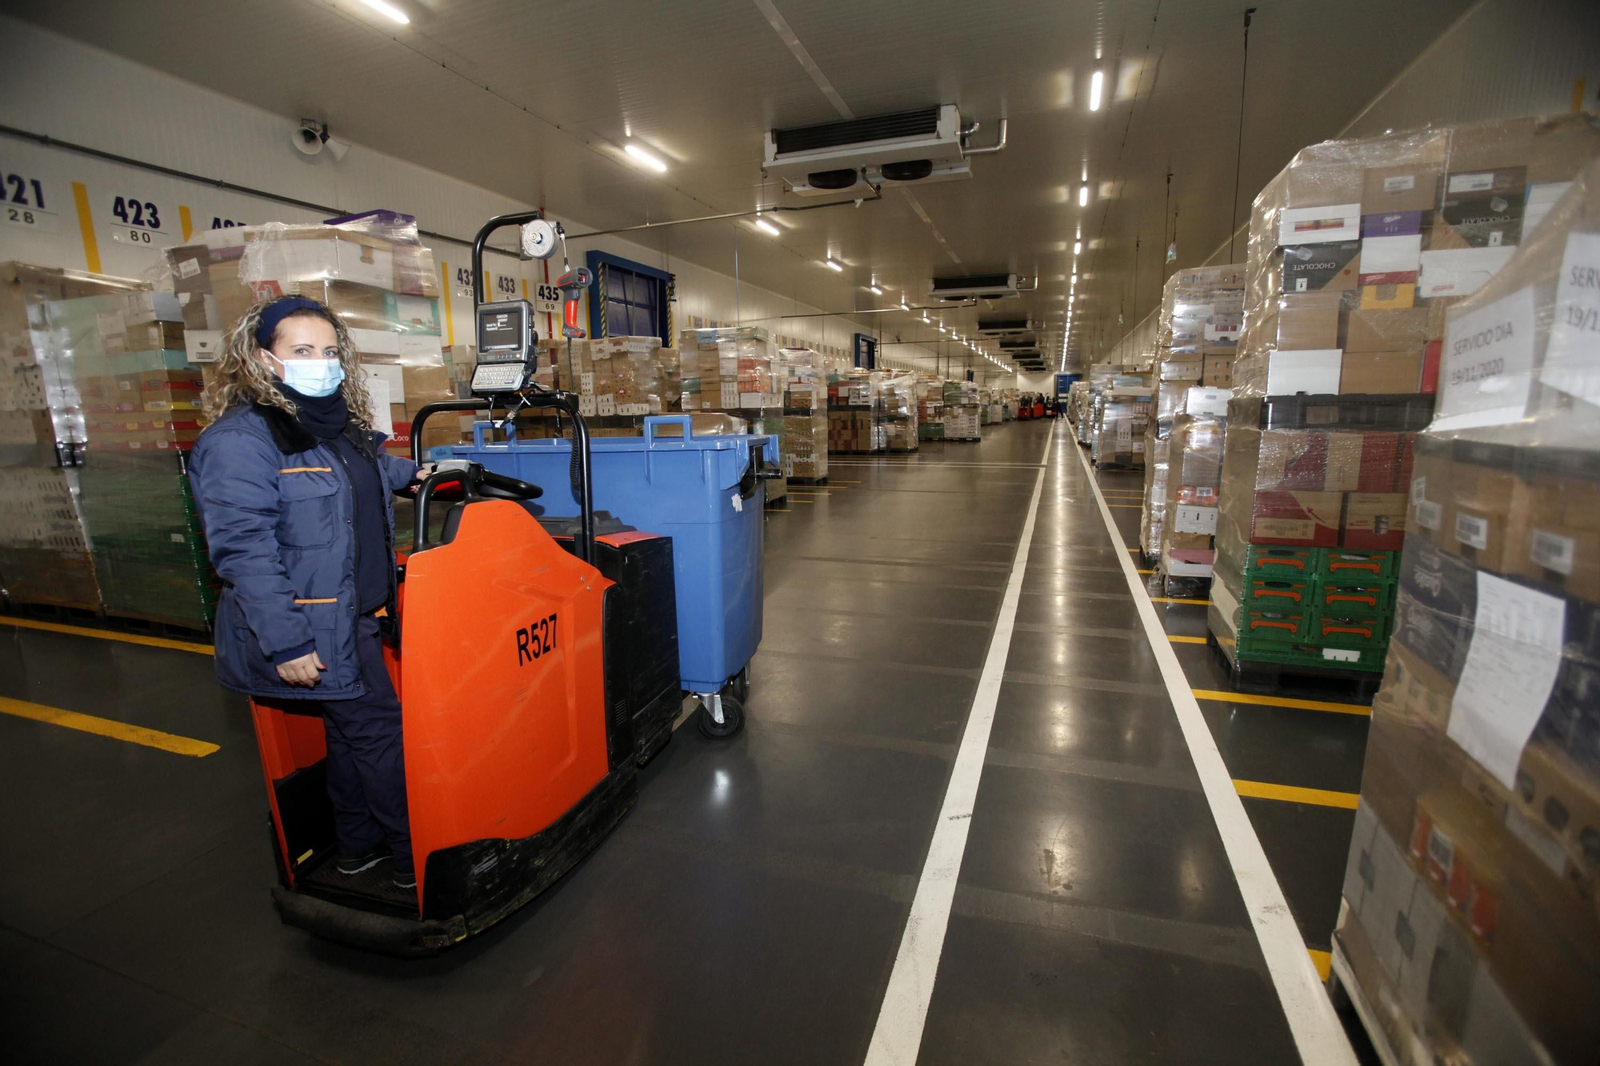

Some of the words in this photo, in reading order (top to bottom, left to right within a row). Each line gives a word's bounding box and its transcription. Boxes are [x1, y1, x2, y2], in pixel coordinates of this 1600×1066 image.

[8, 209, 35, 224] 28
[113, 196, 161, 229] 423
[1462, 215, 1510, 225] CHOCOLATE
[130, 230, 151, 243] 80
[1293, 262, 1336, 271] CHOCOLATE
[498, 276, 516, 294] 433
[538, 285, 559, 301] 435
[545, 302, 555, 310] 69
[1453, 328, 1493, 357] SERVICIO
[516, 612, 557, 667] R527
